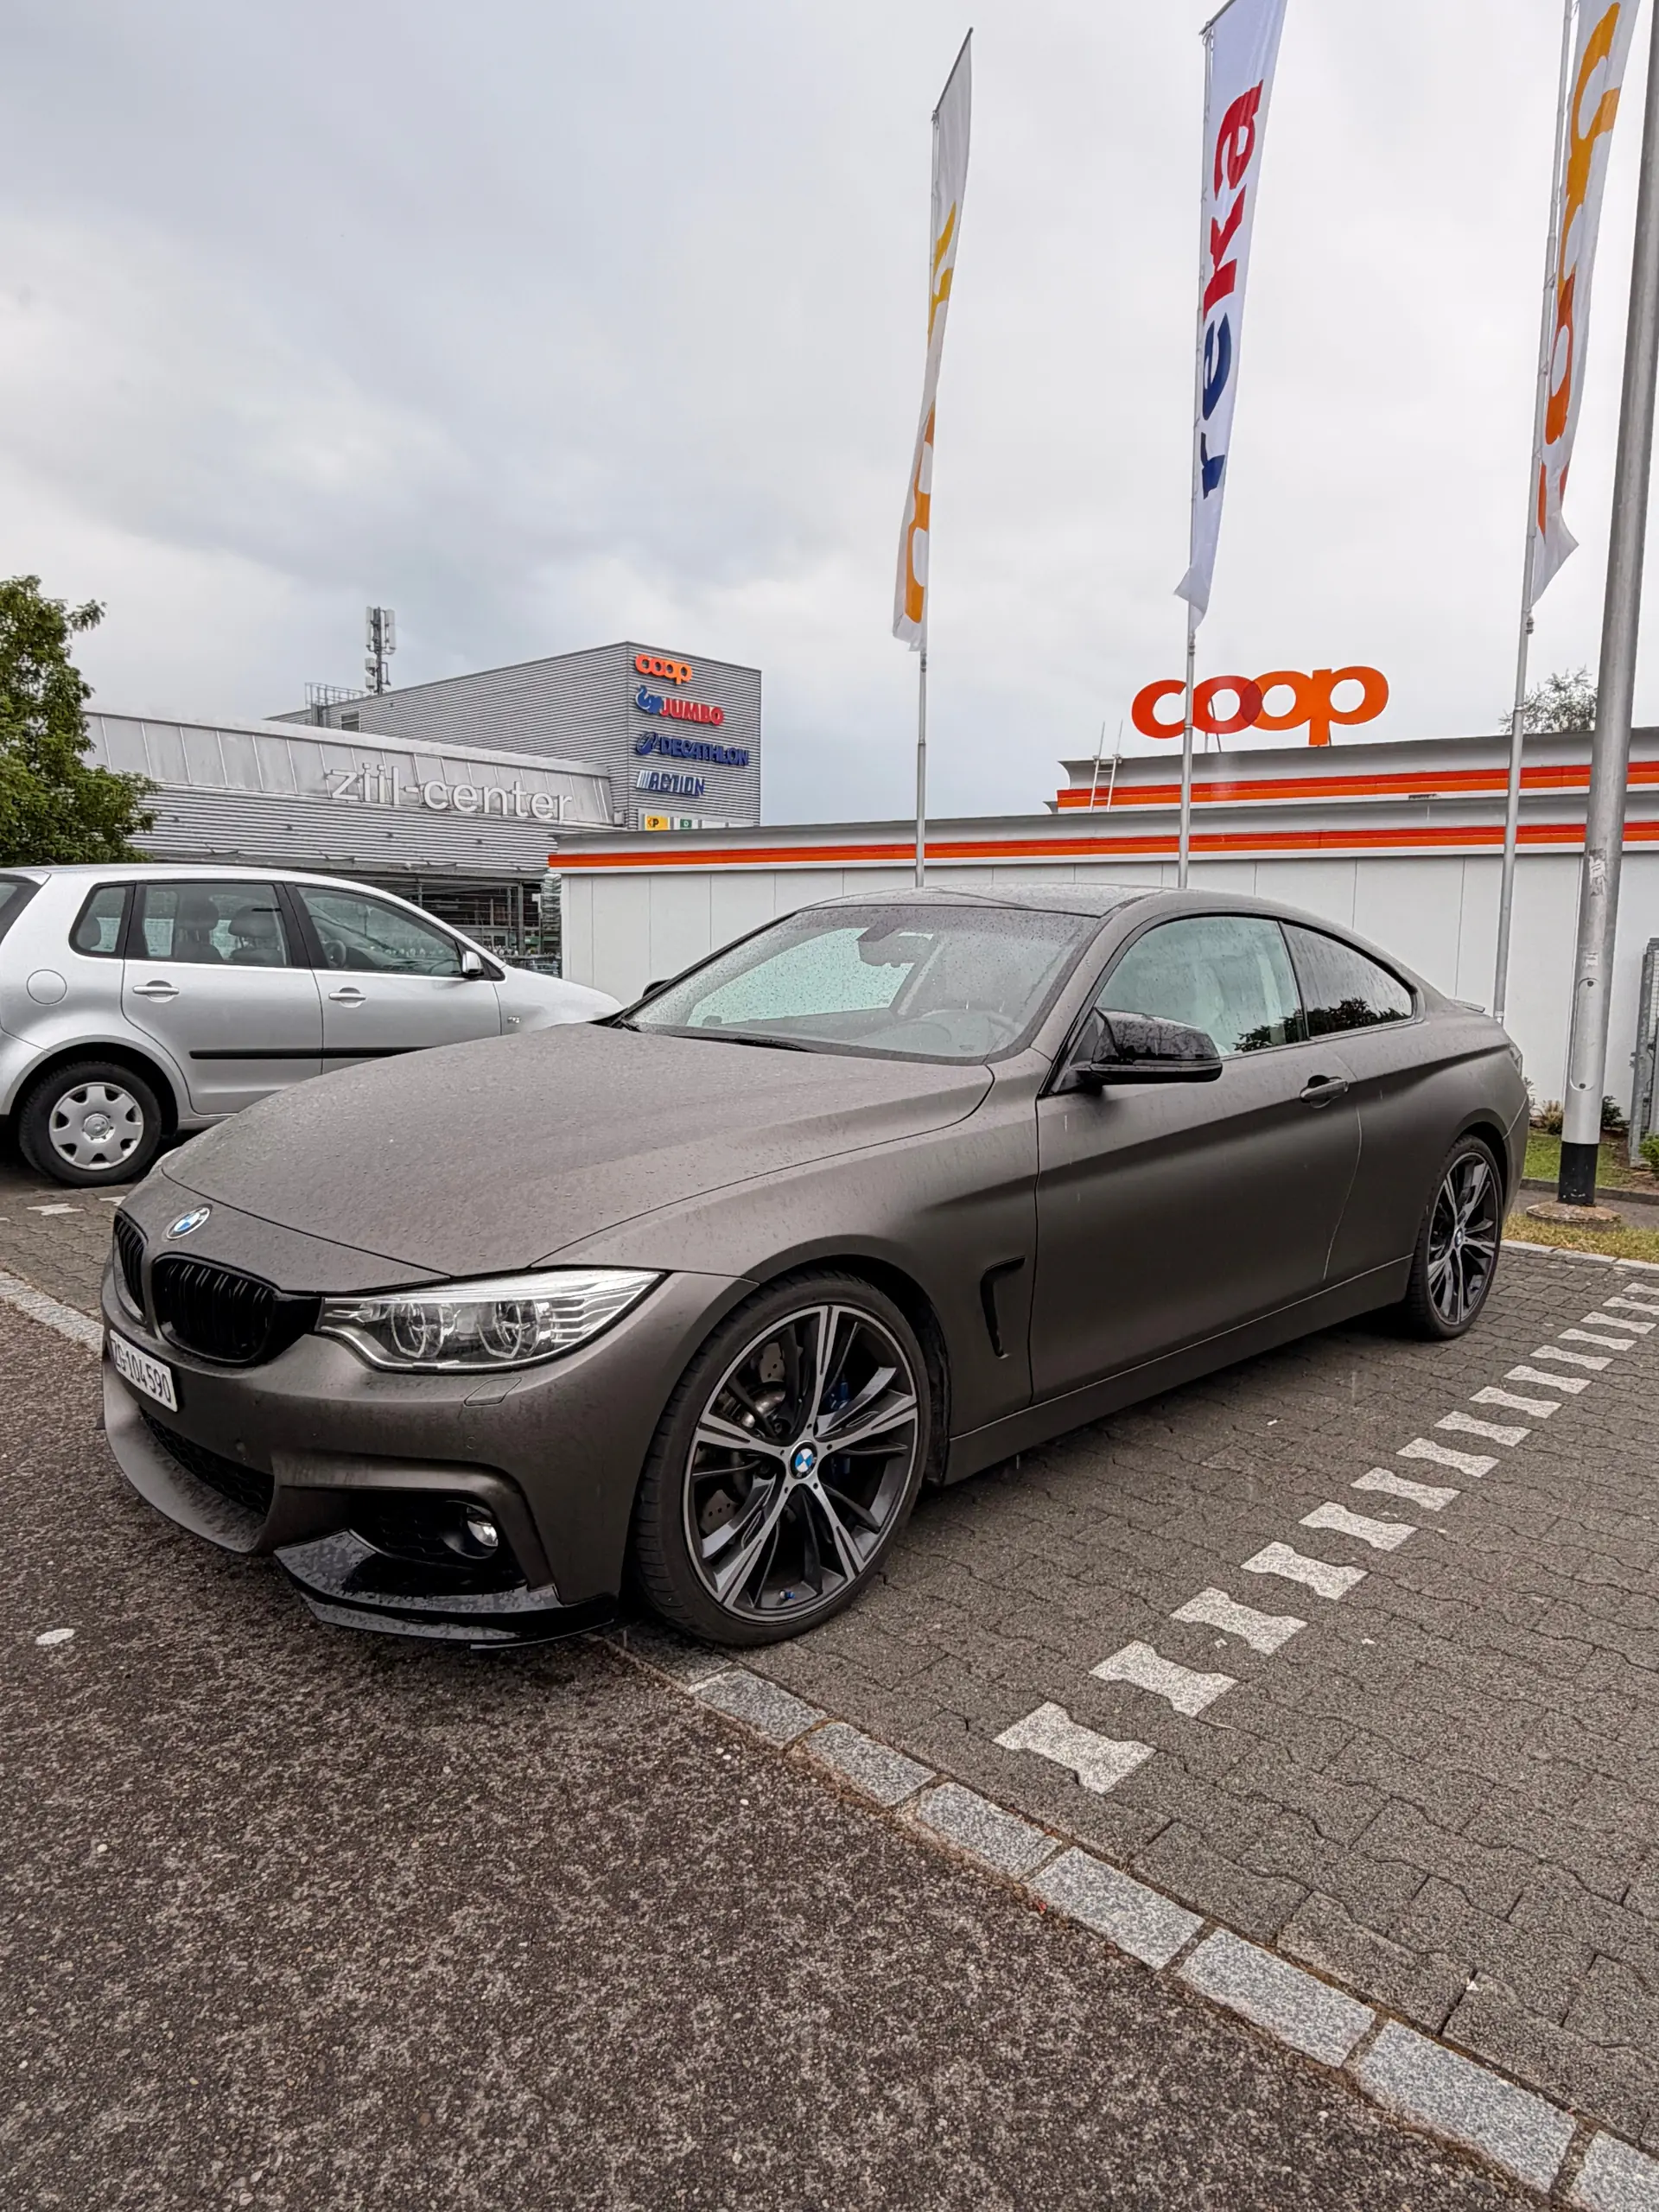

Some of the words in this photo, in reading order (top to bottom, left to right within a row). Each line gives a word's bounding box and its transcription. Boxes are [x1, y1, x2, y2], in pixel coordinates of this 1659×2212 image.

[1200, 79, 1263, 500] reka
[636, 654, 693, 684] coop
[660, 696, 725, 726] JUMBO
[1131, 665, 1389, 746] coop
[660, 736, 749, 766] DECATHLON
[327, 762, 573, 822] ziil-center
[649, 770, 704, 796] ACTION
